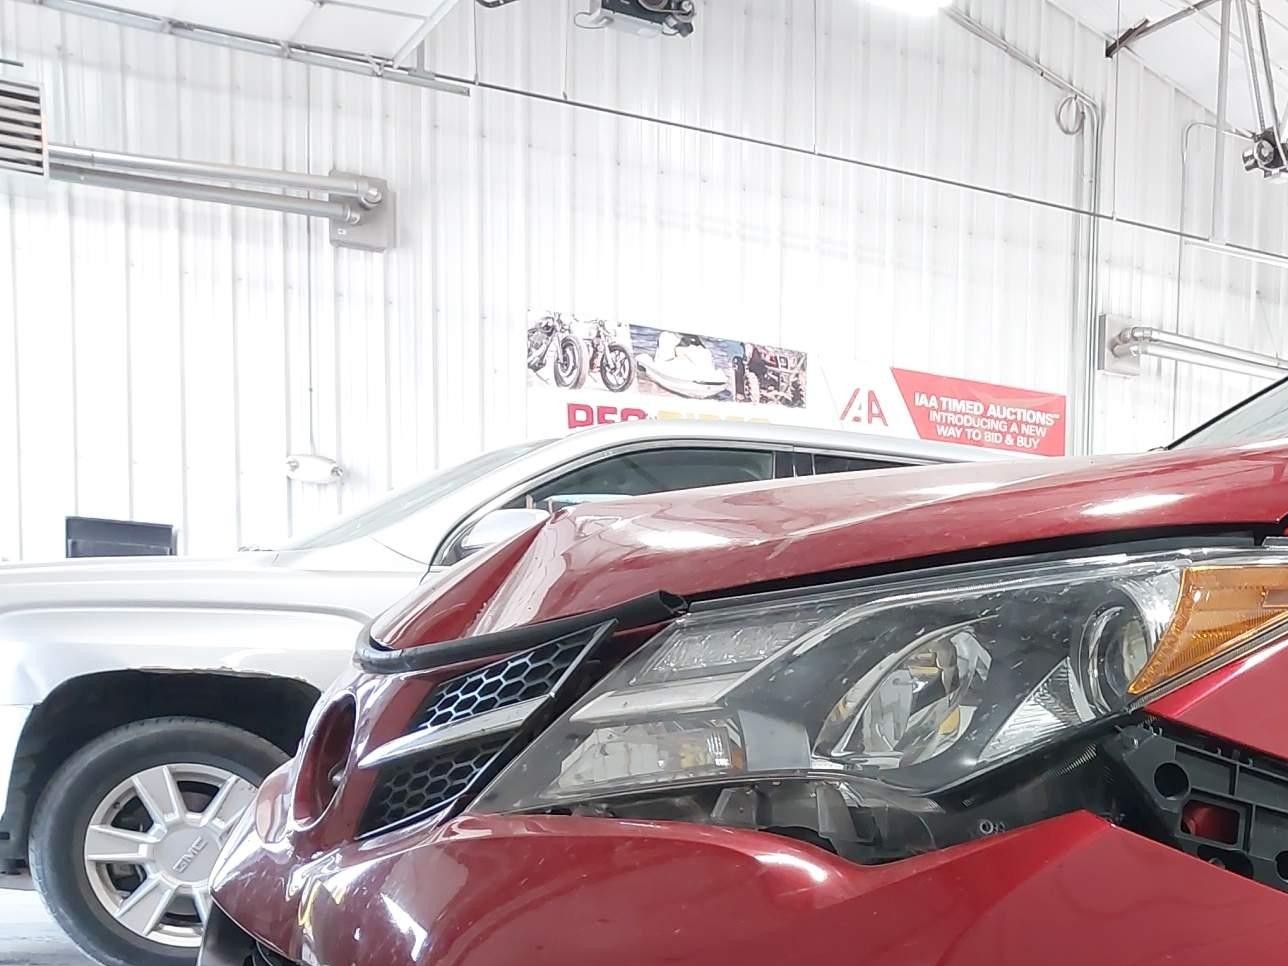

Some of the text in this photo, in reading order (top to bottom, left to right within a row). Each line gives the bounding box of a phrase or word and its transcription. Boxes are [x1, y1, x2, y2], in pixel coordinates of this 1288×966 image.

[914, 392, 938, 409] IAA
[939, 397, 984, 415] TIMED
[929, 411, 1047, 437] INTRODUCING A NEW
[936, 424, 1040, 449] WAY TO BID & BUY
[172, 835, 209, 874] GMC
